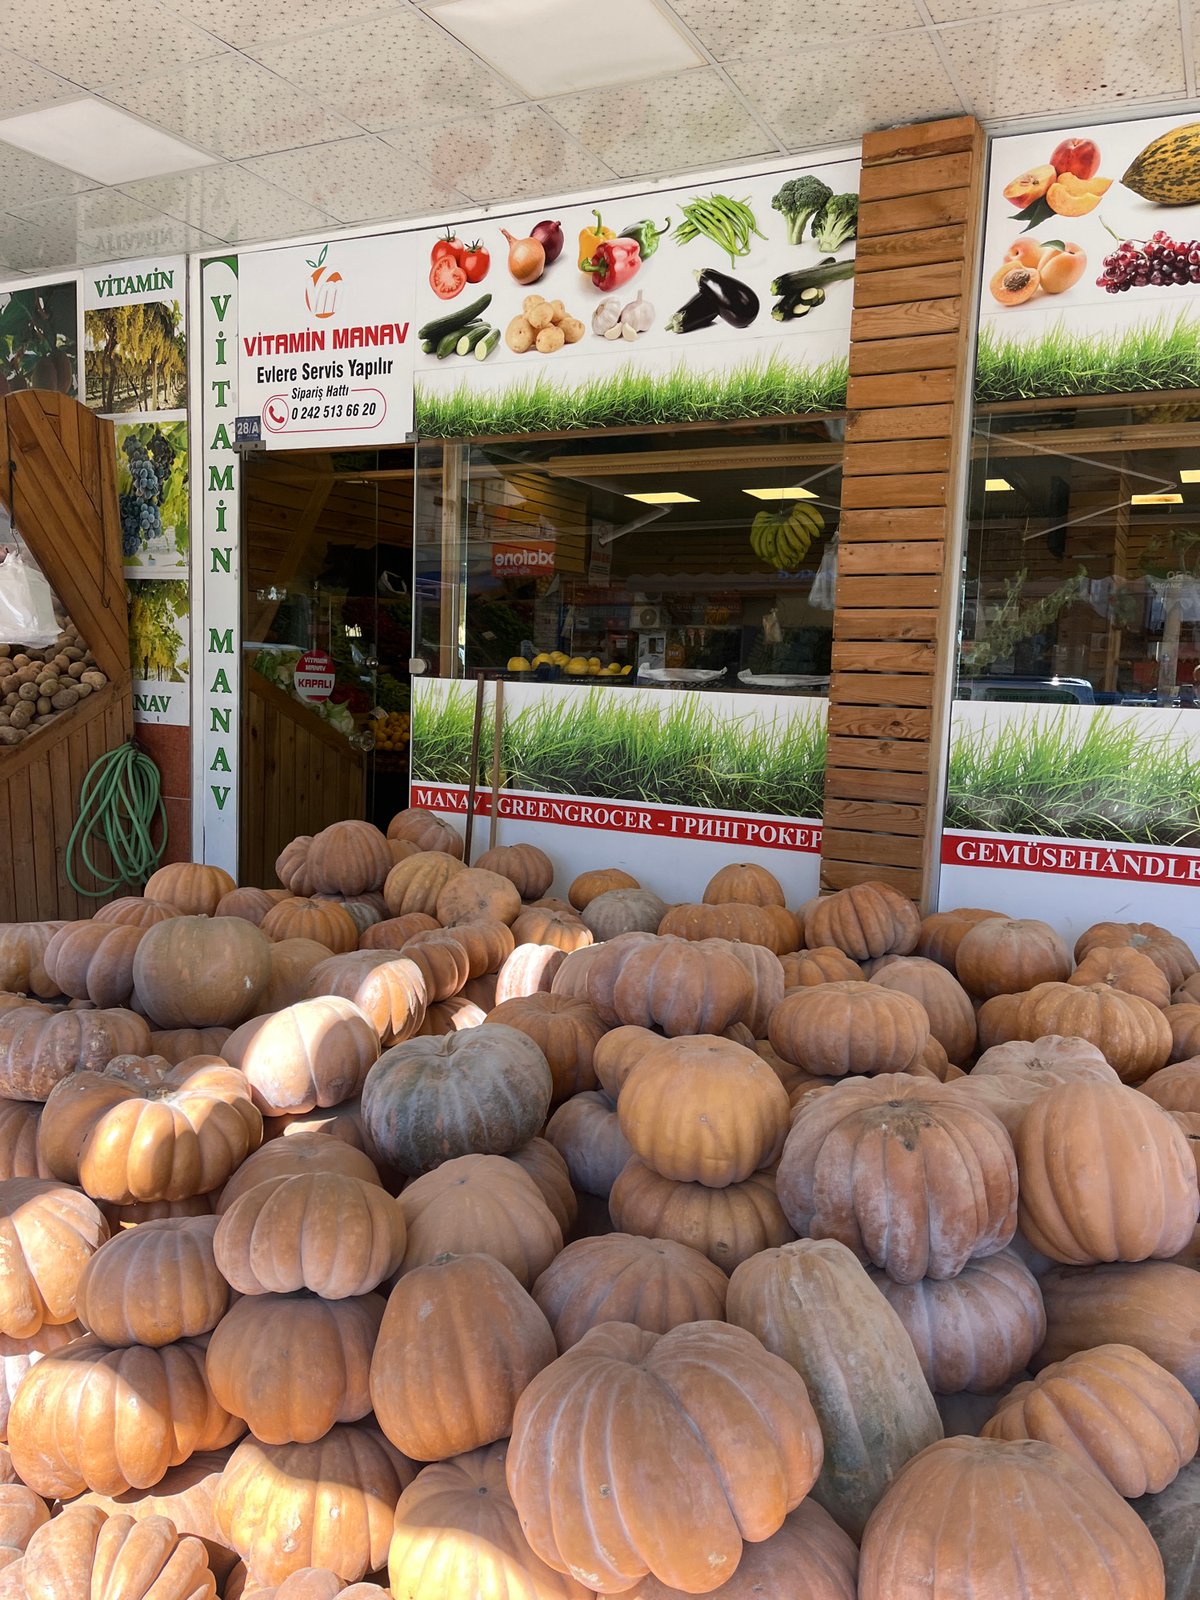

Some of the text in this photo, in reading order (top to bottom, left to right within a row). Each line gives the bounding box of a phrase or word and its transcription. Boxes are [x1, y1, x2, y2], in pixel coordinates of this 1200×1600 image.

[94, 267, 174, 298] VİTAMİN
[243, 322, 410, 357] VİTAMİN MANAV
[256, 356, 394, 384] Evlere Servis Yapılır
[291, 384, 350, 402] Sipariş Hattı
[291, 402, 377, 420] 0 242 513 66 20
[236, 421, 260, 435] 28/A
[208, 295, 235, 811] VİTAMİN MANAV
[298, 679, 333, 688] KAPALI
[497, 797, 654, 830] GREENGROCER
[670, 815, 823, 849] ГРИНГРОКЕР
[955, 841, 1200, 881] GEMÜSEHÄNDLE
